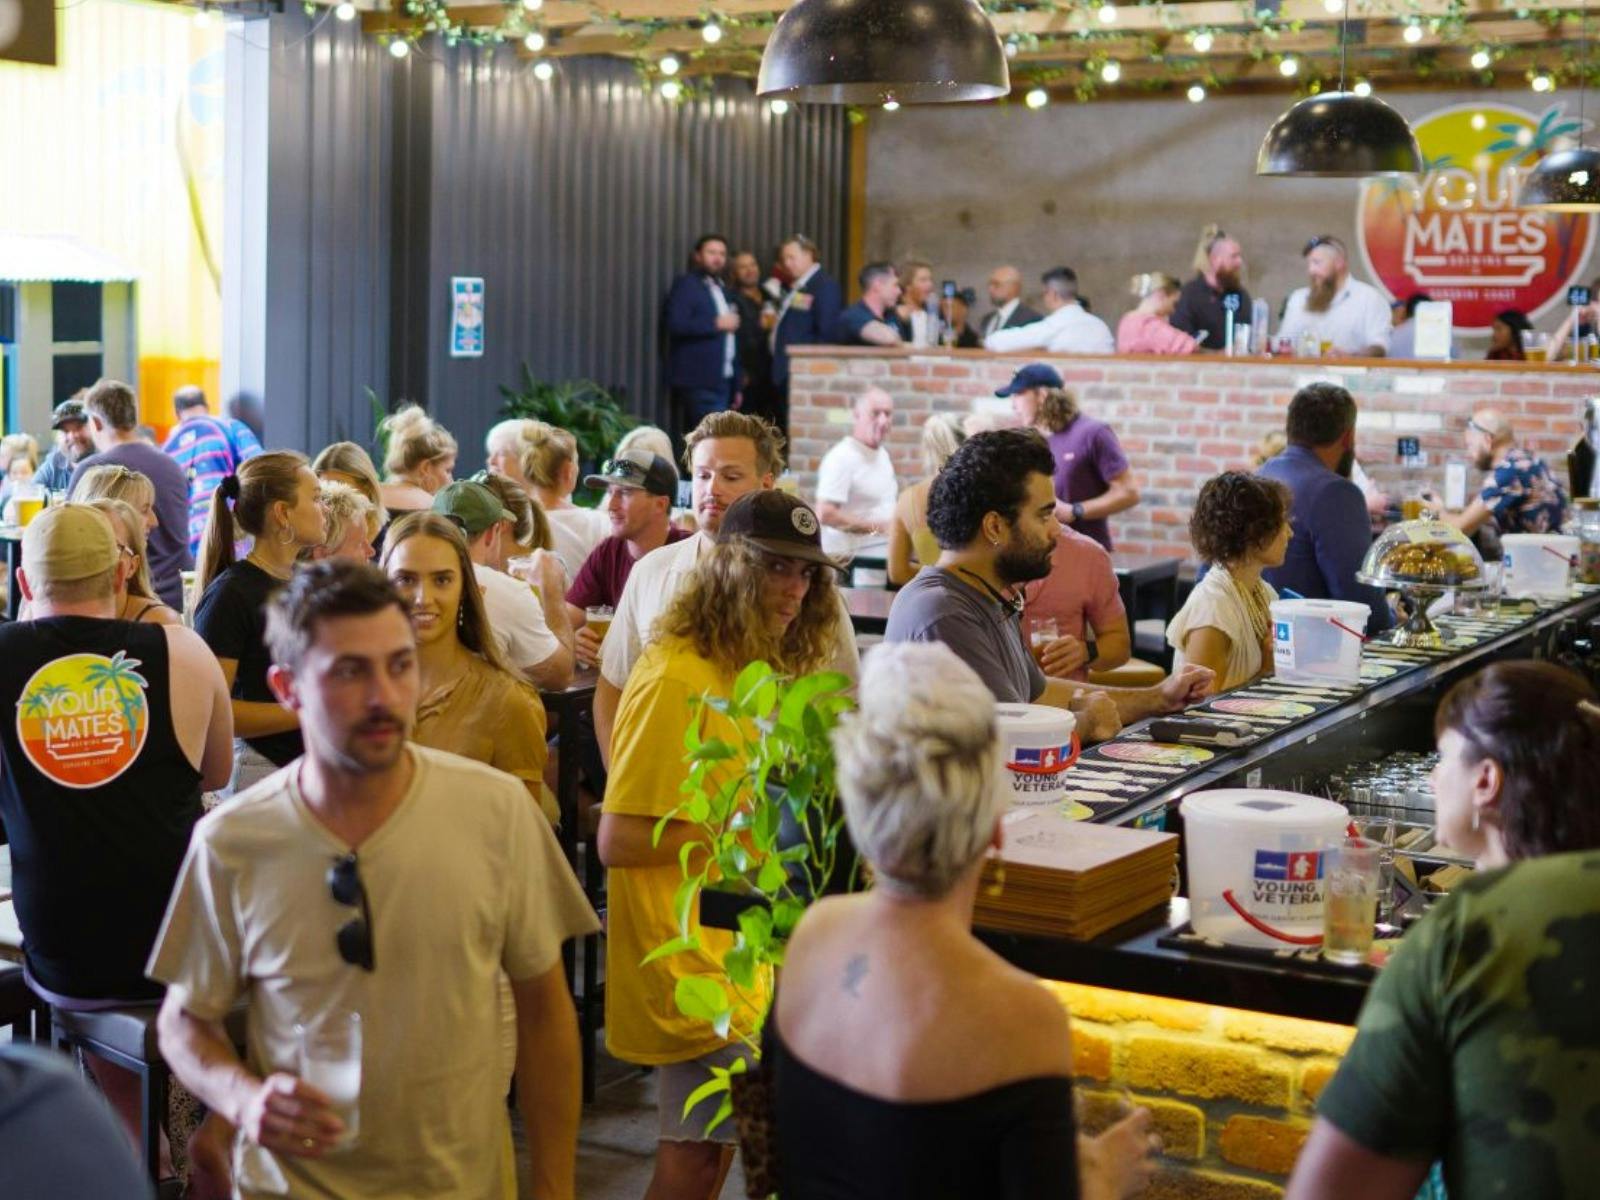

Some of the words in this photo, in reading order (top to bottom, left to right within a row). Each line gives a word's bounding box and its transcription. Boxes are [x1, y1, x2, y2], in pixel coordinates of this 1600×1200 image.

[1405, 212, 1547, 254] MATES
[40, 686, 121, 717] YOUR
[45, 711, 124, 741] MATES
[1013, 772, 1059, 783] YOUNG
[1253, 880, 1316, 893] YOUNG
